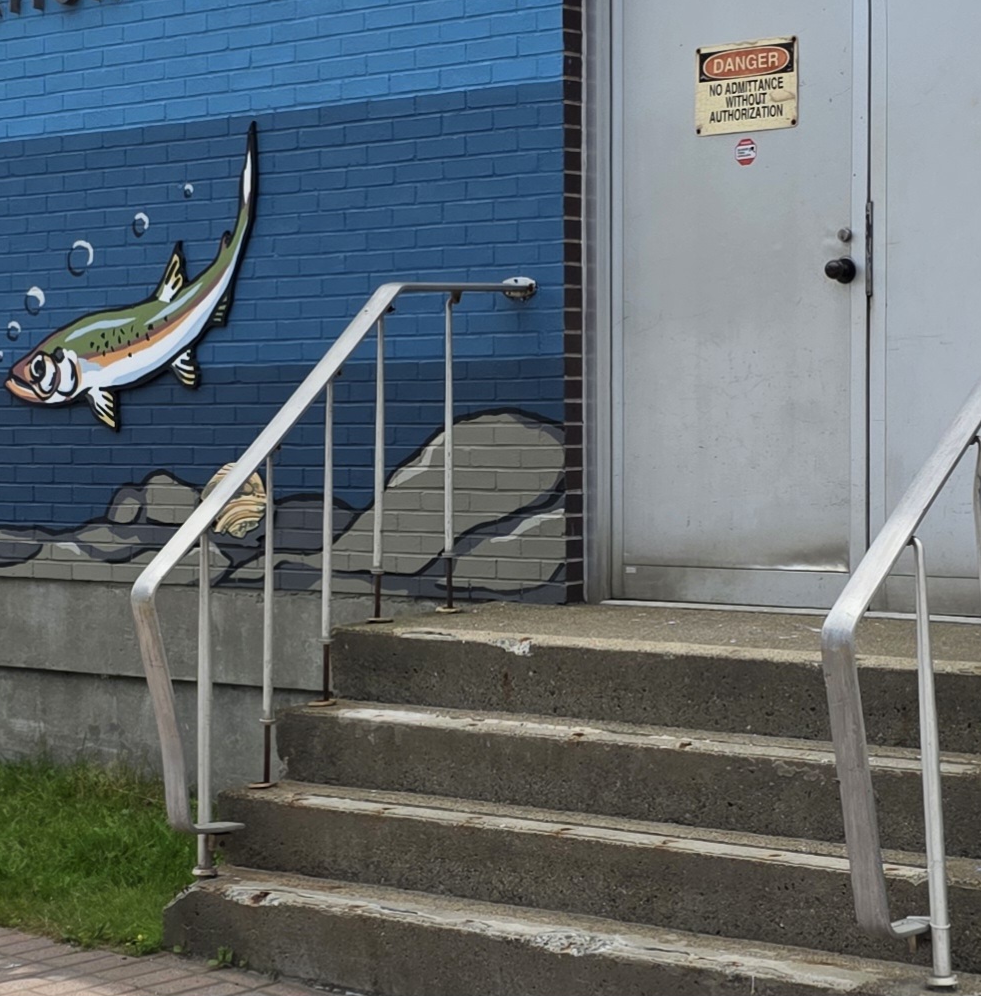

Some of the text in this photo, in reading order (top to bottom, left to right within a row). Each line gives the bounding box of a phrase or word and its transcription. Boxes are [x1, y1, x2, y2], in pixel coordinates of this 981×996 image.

[713, 52, 779, 74] DANGER
[709, 76, 784, 97] NO ADMITTANCE
[725, 92, 767, 108] WITHOUT
[709, 104, 783, 124] AUTHORIZATION
